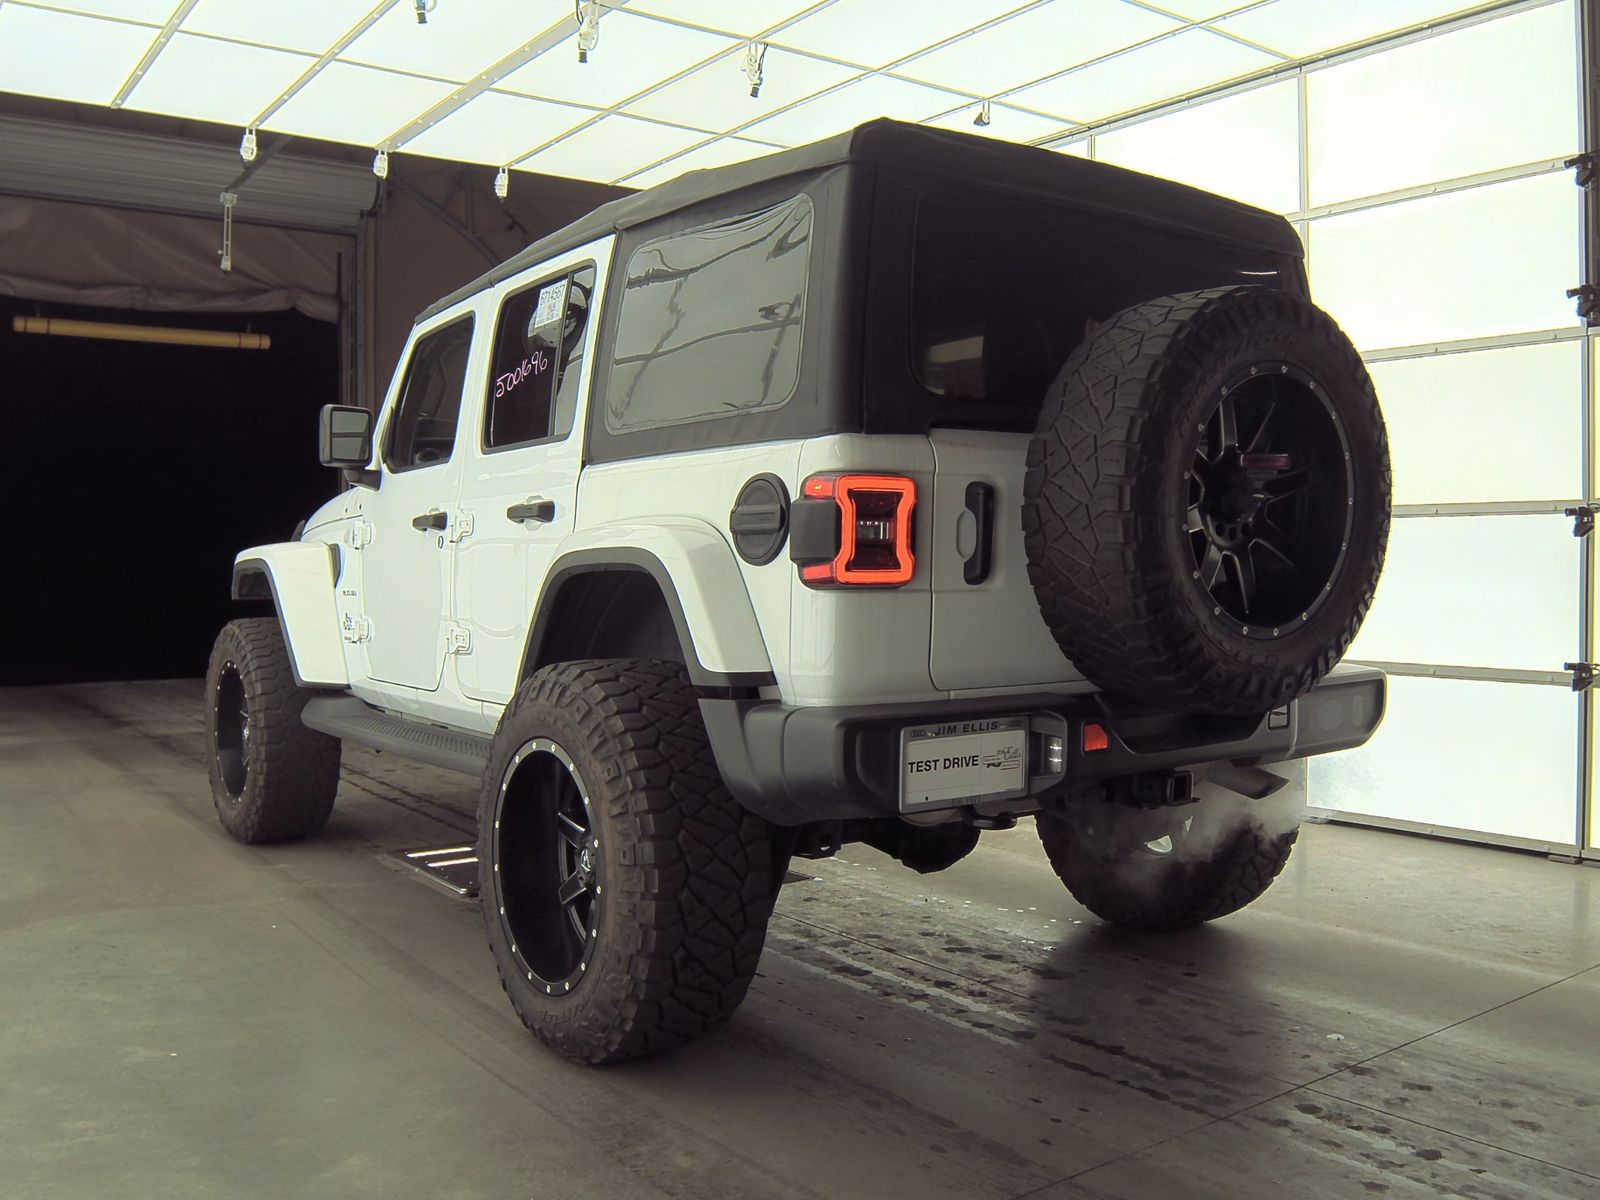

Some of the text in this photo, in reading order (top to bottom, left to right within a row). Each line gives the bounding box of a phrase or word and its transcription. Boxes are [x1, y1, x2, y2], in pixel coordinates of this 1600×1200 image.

[935, 721, 998, 736] JIM ELLIS
[908, 759, 940, 773] TEST
[943, 755, 979, 770] DRIVE
